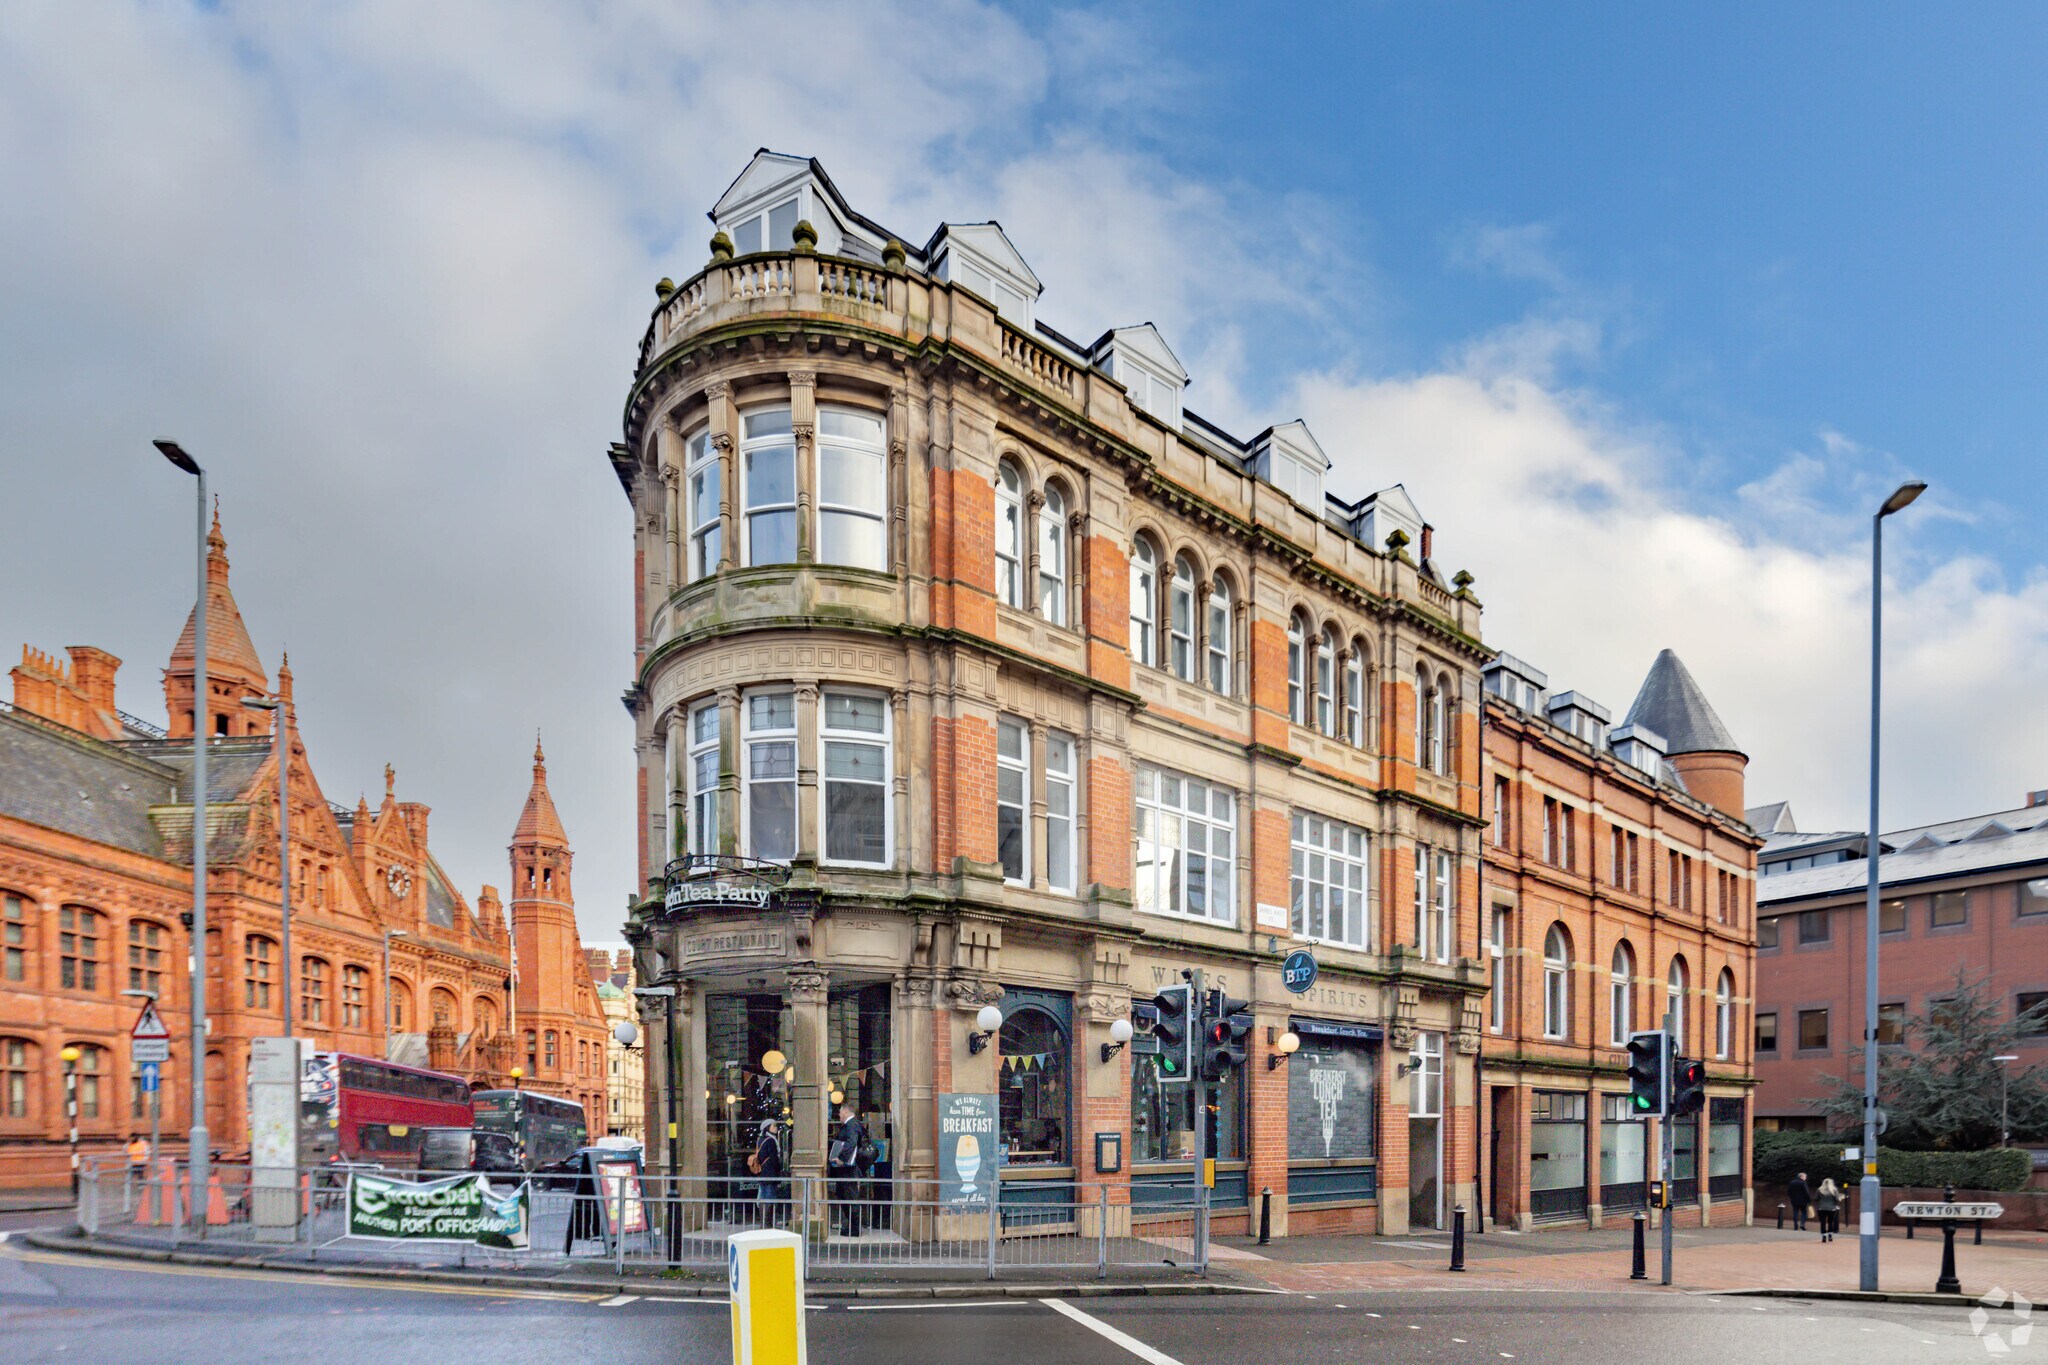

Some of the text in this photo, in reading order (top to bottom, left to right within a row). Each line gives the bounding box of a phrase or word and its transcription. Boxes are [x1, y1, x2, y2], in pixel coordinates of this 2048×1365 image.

[681, 883, 713, 902] Tea
[715, 882, 769, 908] Party
[1151, 966, 1226, 990] WIES
[1285, 967, 1312, 984] BTP
[1309, 1069, 1347, 1085] BREAKFAST
[1313, 1081, 1343, 1100] LUNCH
[961, 1106, 975, 1116] TIME
[1319, 1100, 1337, 1120] TEA
[943, 1118, 992, 1133] BREAKFAST
[1906, 1206, 1962, 1216] NEWTON
[1970, 1206, 1987, 1216] ST
[353, 1212, 398, 1232] ANOTHER
[400, 1217, 432, 1233] POST
[435, 1217, 479, 1233] OFFICE
